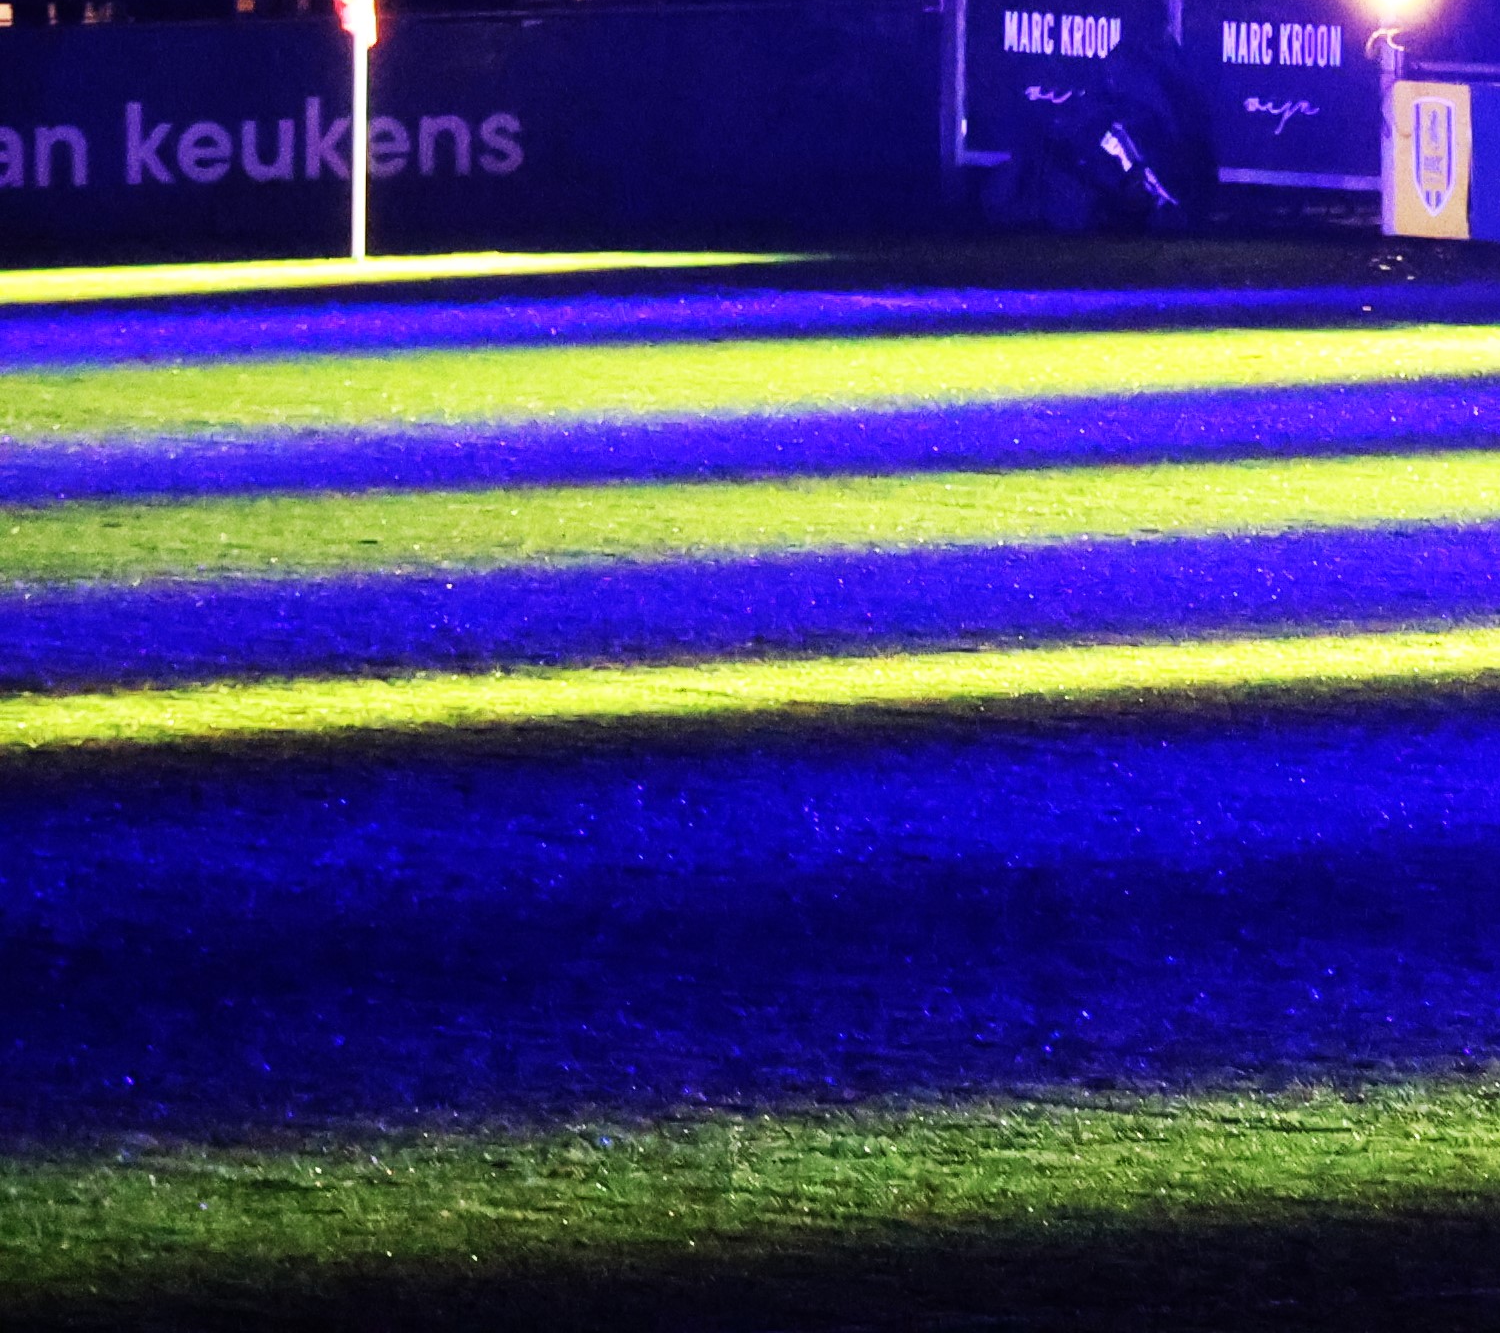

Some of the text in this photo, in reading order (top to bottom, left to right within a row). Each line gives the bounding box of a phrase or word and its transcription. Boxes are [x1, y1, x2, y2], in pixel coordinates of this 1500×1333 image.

[1004, 10, 1054, 55] MARC
[1222, 20, 1341, 67] MARC KROON
[125, 97, 525, 185] keukens
